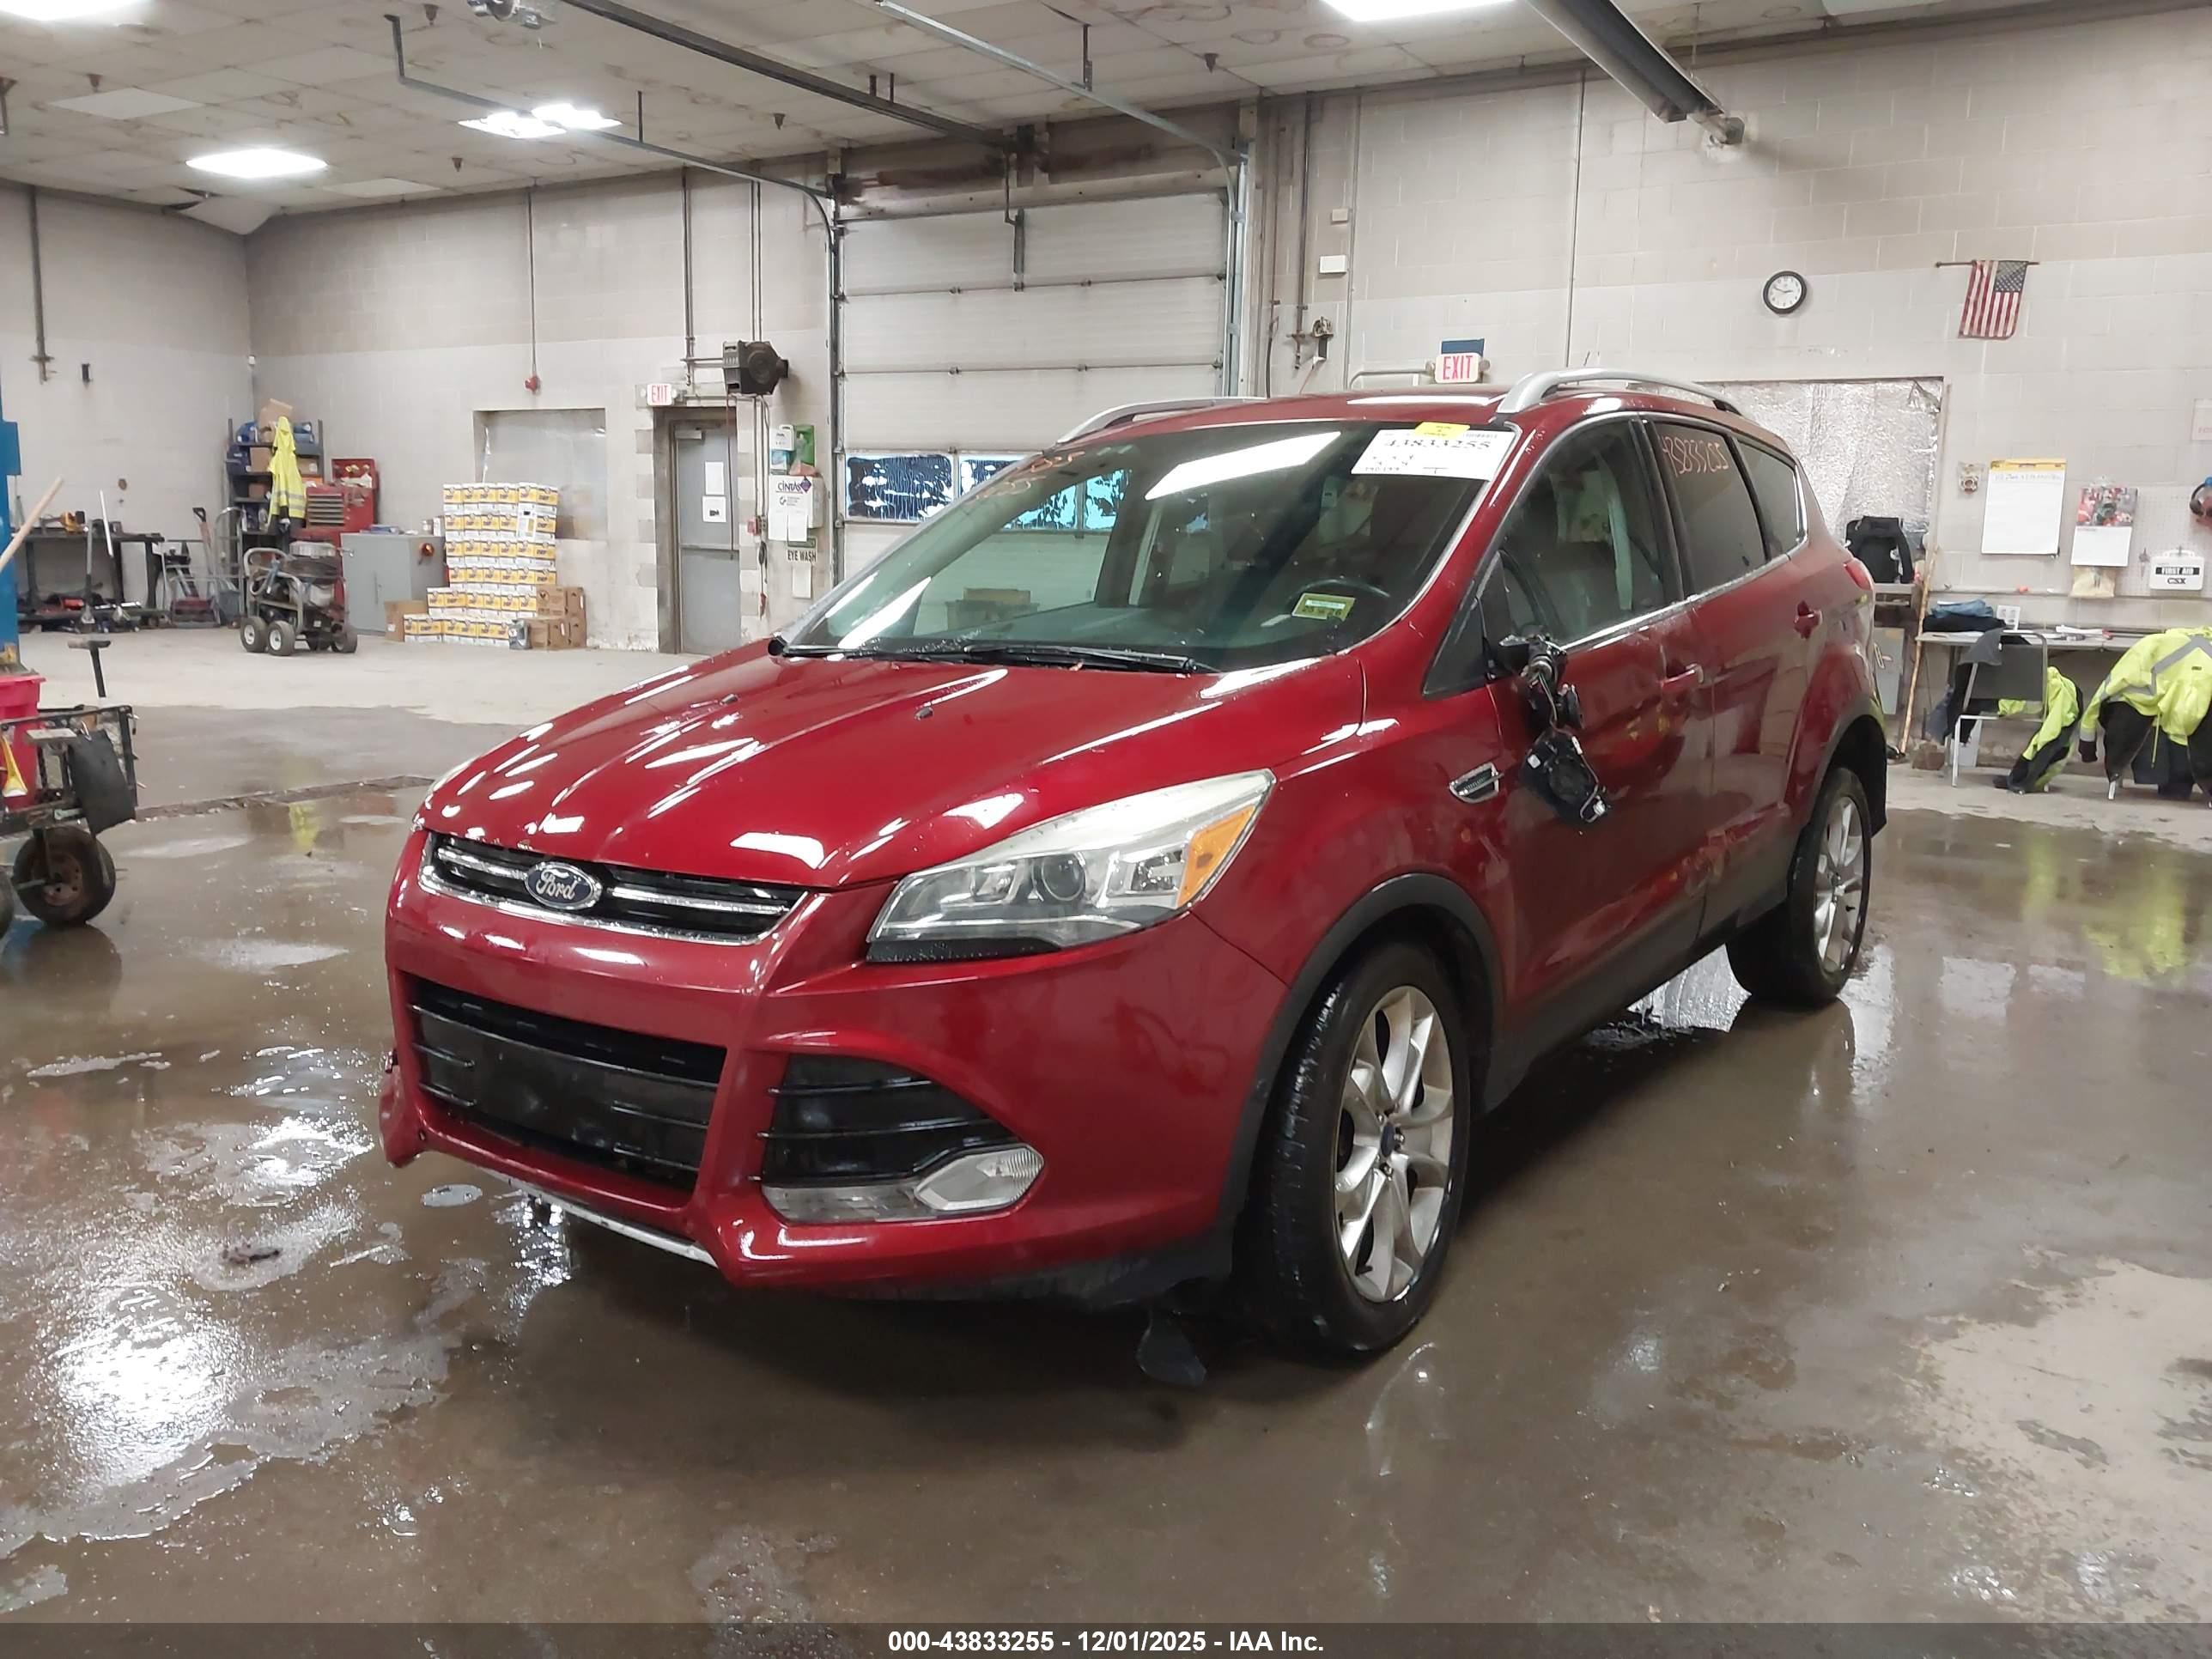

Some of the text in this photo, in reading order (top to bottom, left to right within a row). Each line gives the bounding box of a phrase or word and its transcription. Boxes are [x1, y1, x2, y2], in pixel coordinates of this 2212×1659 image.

[1443, 355, 1474, 380] EXIT
[651, 385, 668, 404] EXIT
[787, 550, 817, 563] EYE WASH
[2161, 566, 2195, 575] FIRST AID
[536, 868, 579, 900] Ford
